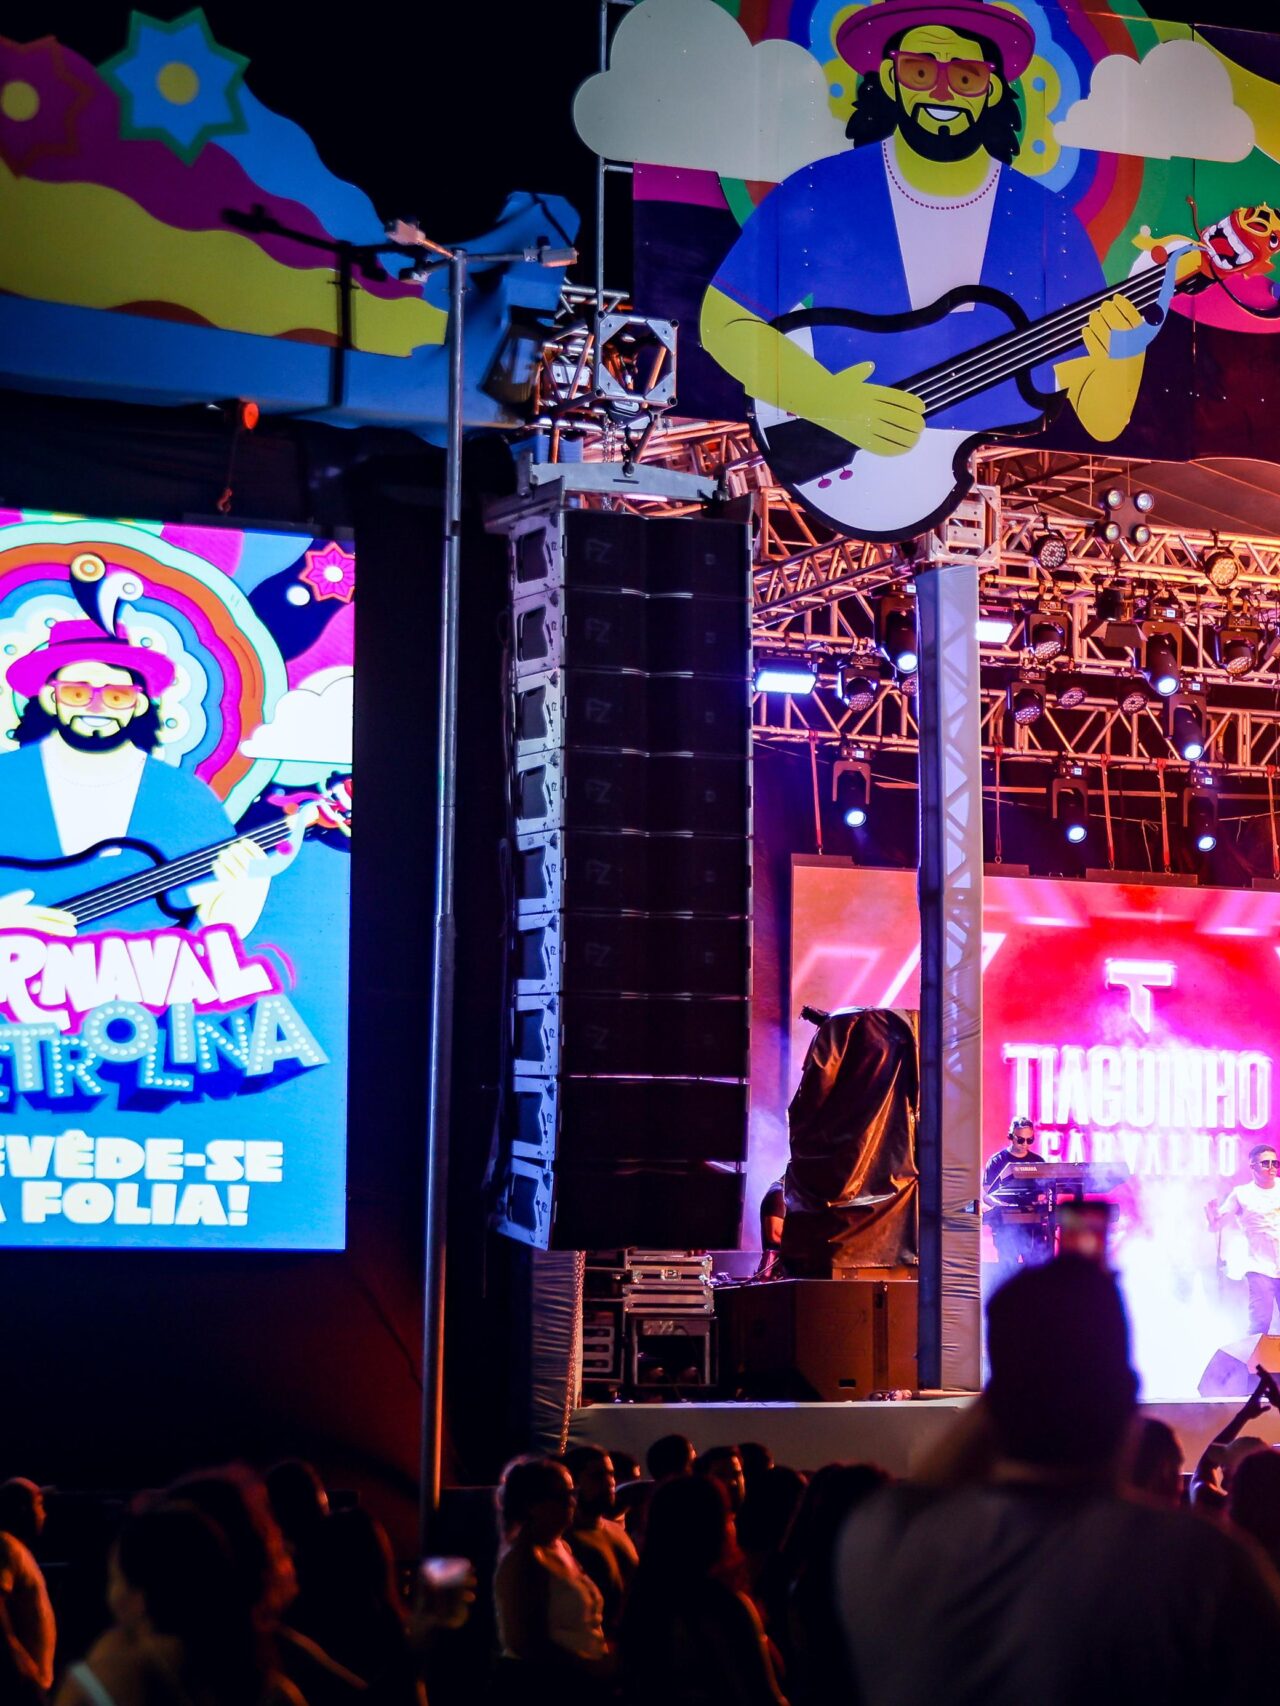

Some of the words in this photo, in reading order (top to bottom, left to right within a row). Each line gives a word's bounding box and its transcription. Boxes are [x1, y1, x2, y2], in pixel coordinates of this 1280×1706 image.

[0, 995, 331, 1097] TROLINA
[1003, 1043, 1271, 1130] TIAGUINHO
[0, 1129, 284, 1182] VÊDE-SE
[22, 1181, 250, 1226] FOLIA!
